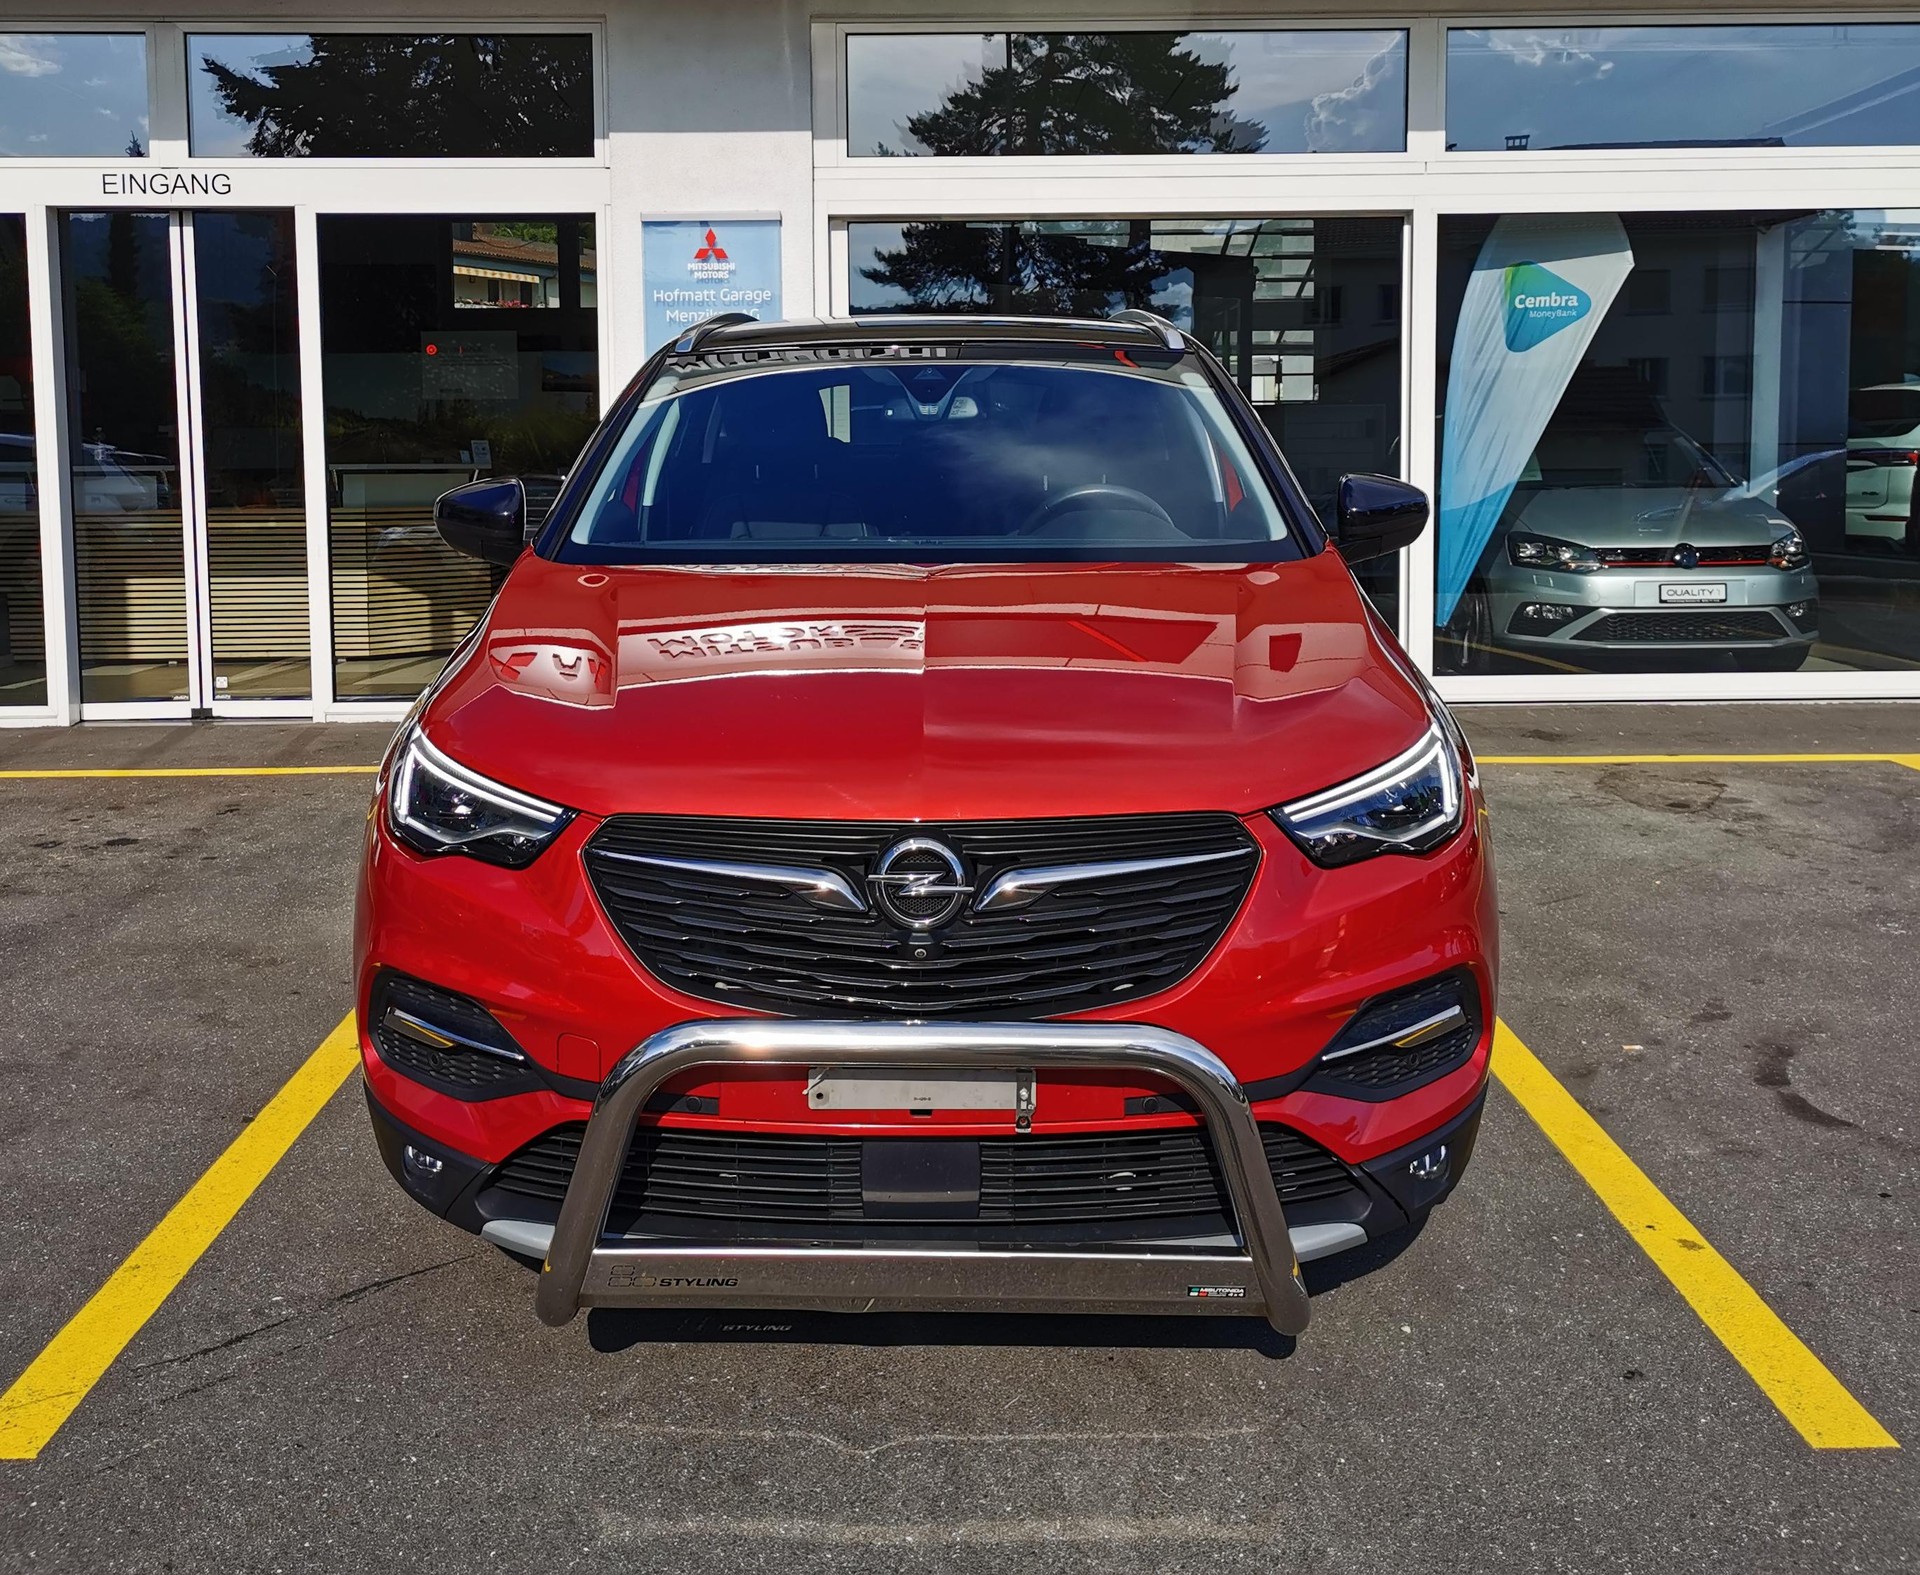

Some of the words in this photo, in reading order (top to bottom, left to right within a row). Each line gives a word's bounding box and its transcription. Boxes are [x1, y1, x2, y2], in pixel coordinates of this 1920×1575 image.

[102, 173, 231, 195] EINGANG
[687, 262, 736, 271] MITSUBISHI
[694, 271, 729, 279] MOTORS
[653, 289, 716, 302] Hofmatt
[720, 288, 772, 304] Garage
[1514, 291, 1579, 309] Cembra
[1529, 309, 1577, 319] MoneyBank
[1666, 588, 1714, 597] QUALITY
[659, 1277, 739, 1288] STYLING
